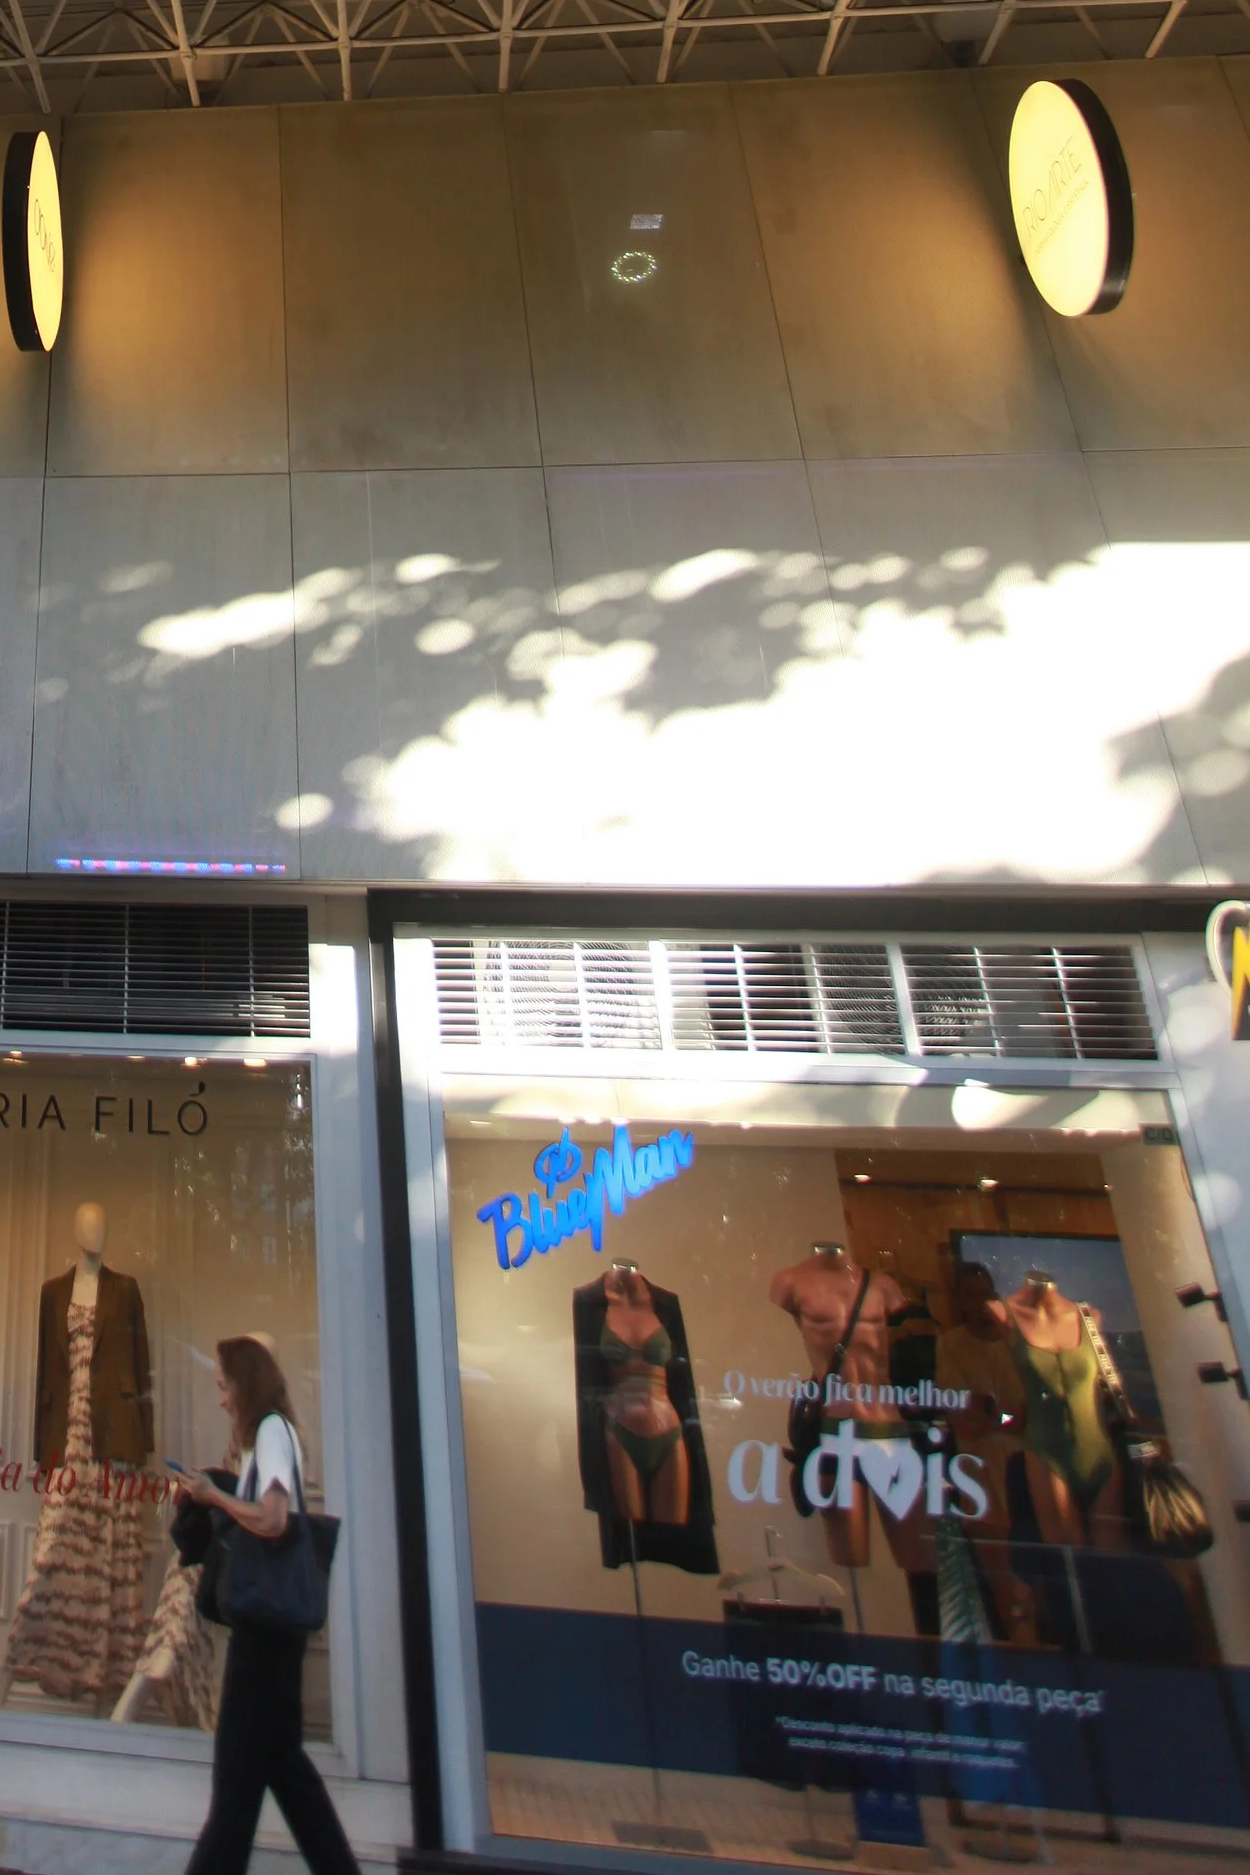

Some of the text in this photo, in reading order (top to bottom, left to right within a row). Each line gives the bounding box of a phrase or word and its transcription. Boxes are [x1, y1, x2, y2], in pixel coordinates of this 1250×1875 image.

[94, 1081, 208, 1136] FILÓ
[724, 1370, 970, 1409] O verão fica melhor
[32, 1450, 77, 1496] do
[727, 1439, 783, 1505] a
[682, 1650, 760, 1681] Ganhe
[884, 1672, 915, 1696] na
[923, 1673, 1030, 1706] segunda
